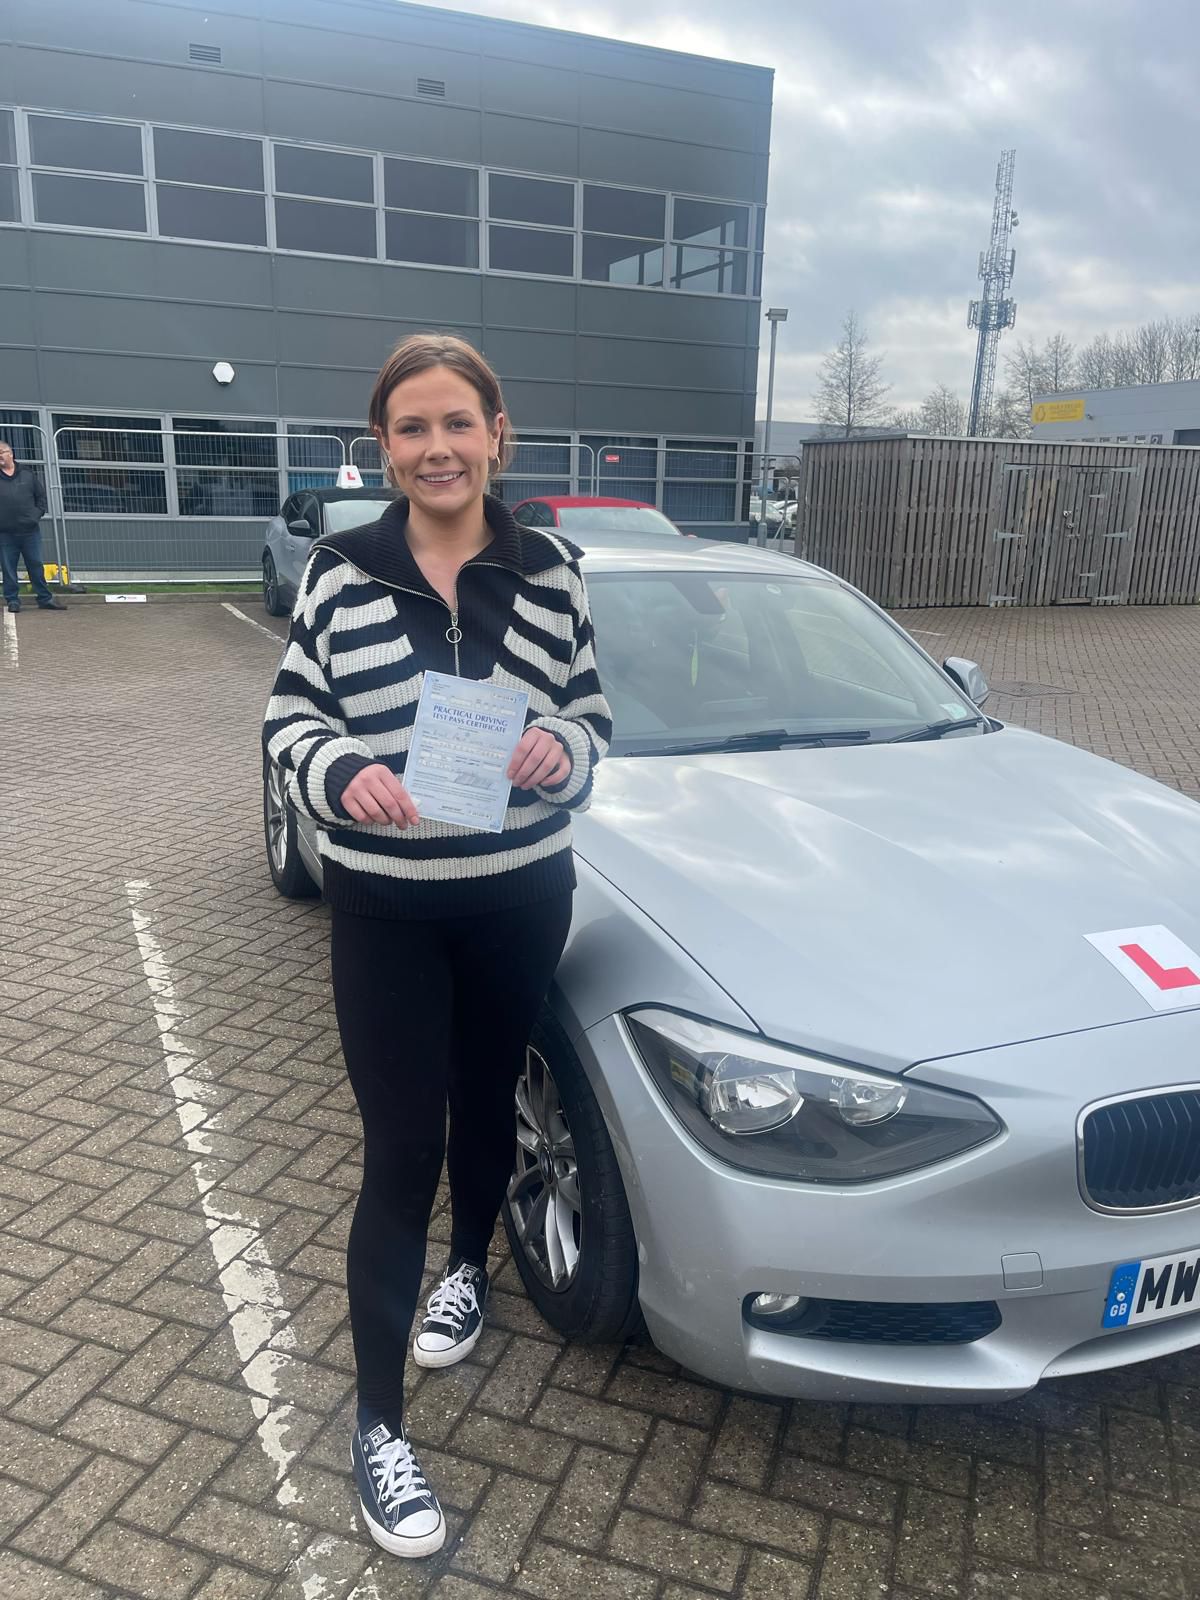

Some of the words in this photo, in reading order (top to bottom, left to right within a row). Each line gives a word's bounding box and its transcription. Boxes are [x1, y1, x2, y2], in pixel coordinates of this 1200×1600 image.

[347, 471, 355, 480] L
[432, 712, 447, 720] TEST
[448, 715, 465, 724] PASS
[466, 719, 507, 733] CERTIFICATE
[433, 704, 472, 719] PRACTICAL
[474, 714, 508, 727] DRIVING
[1118, 943, 1200, 990] L
[1136, 1255, 1200, 1314] MW
[1110, 1303, 1128, 1317] GB
